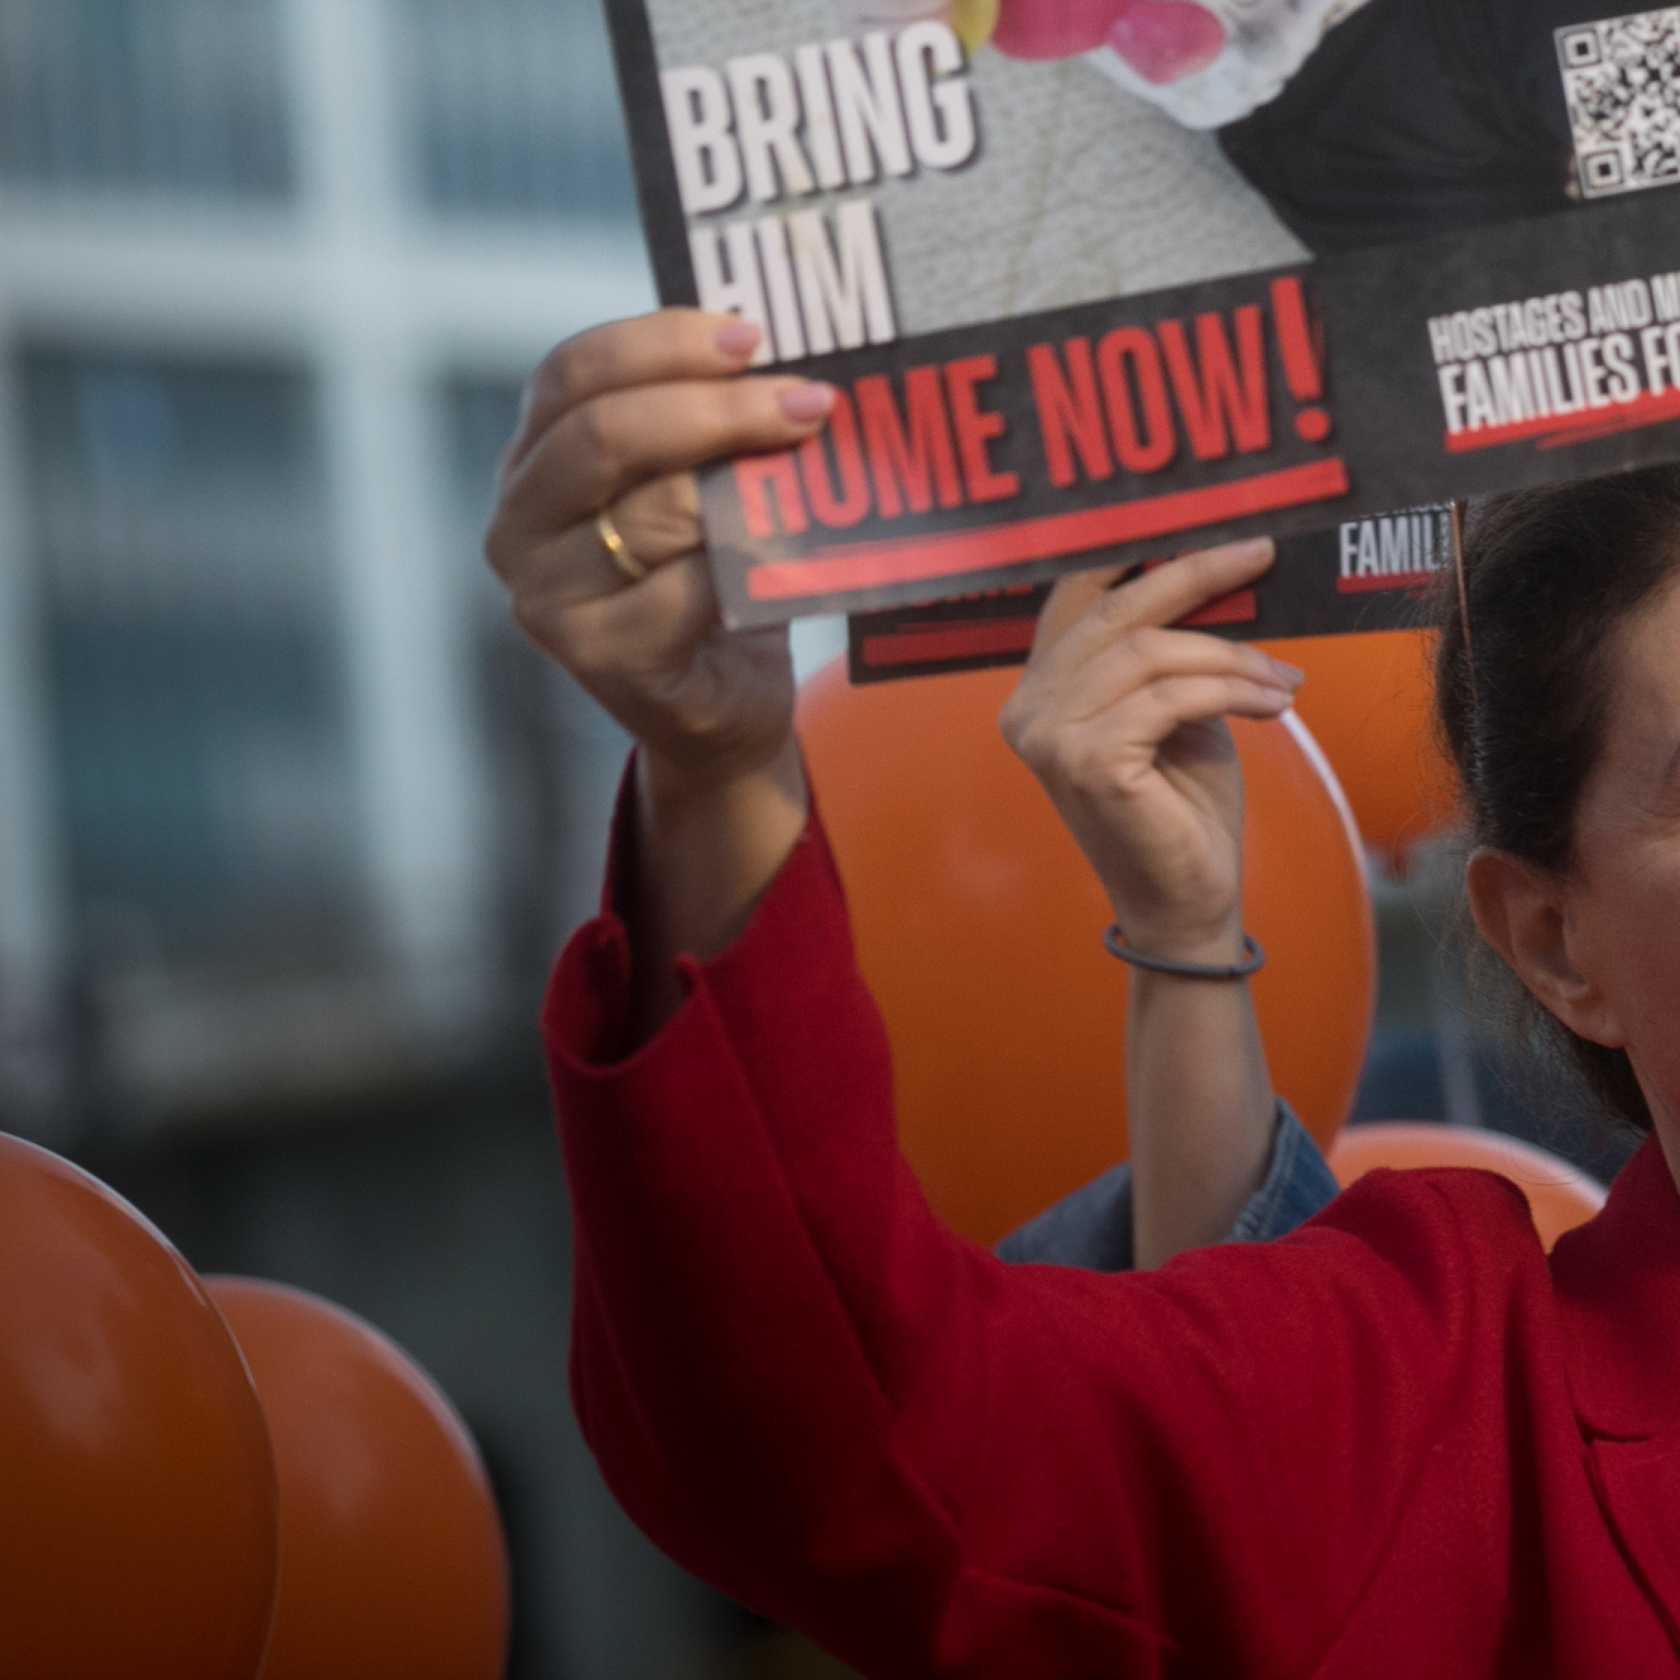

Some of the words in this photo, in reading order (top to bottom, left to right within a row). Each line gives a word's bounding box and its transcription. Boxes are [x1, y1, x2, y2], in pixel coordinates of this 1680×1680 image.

[660, 20, 979, 216] BRING
[689, 198, 897, 368] HIM
[1427, 290, 1587, 365] HOSTAGES
[1587, 278, 1652, 335] AND
[1027, 274, 1333, 488] NOW!
[1437, 331, 1641, 435] FAMILIES
